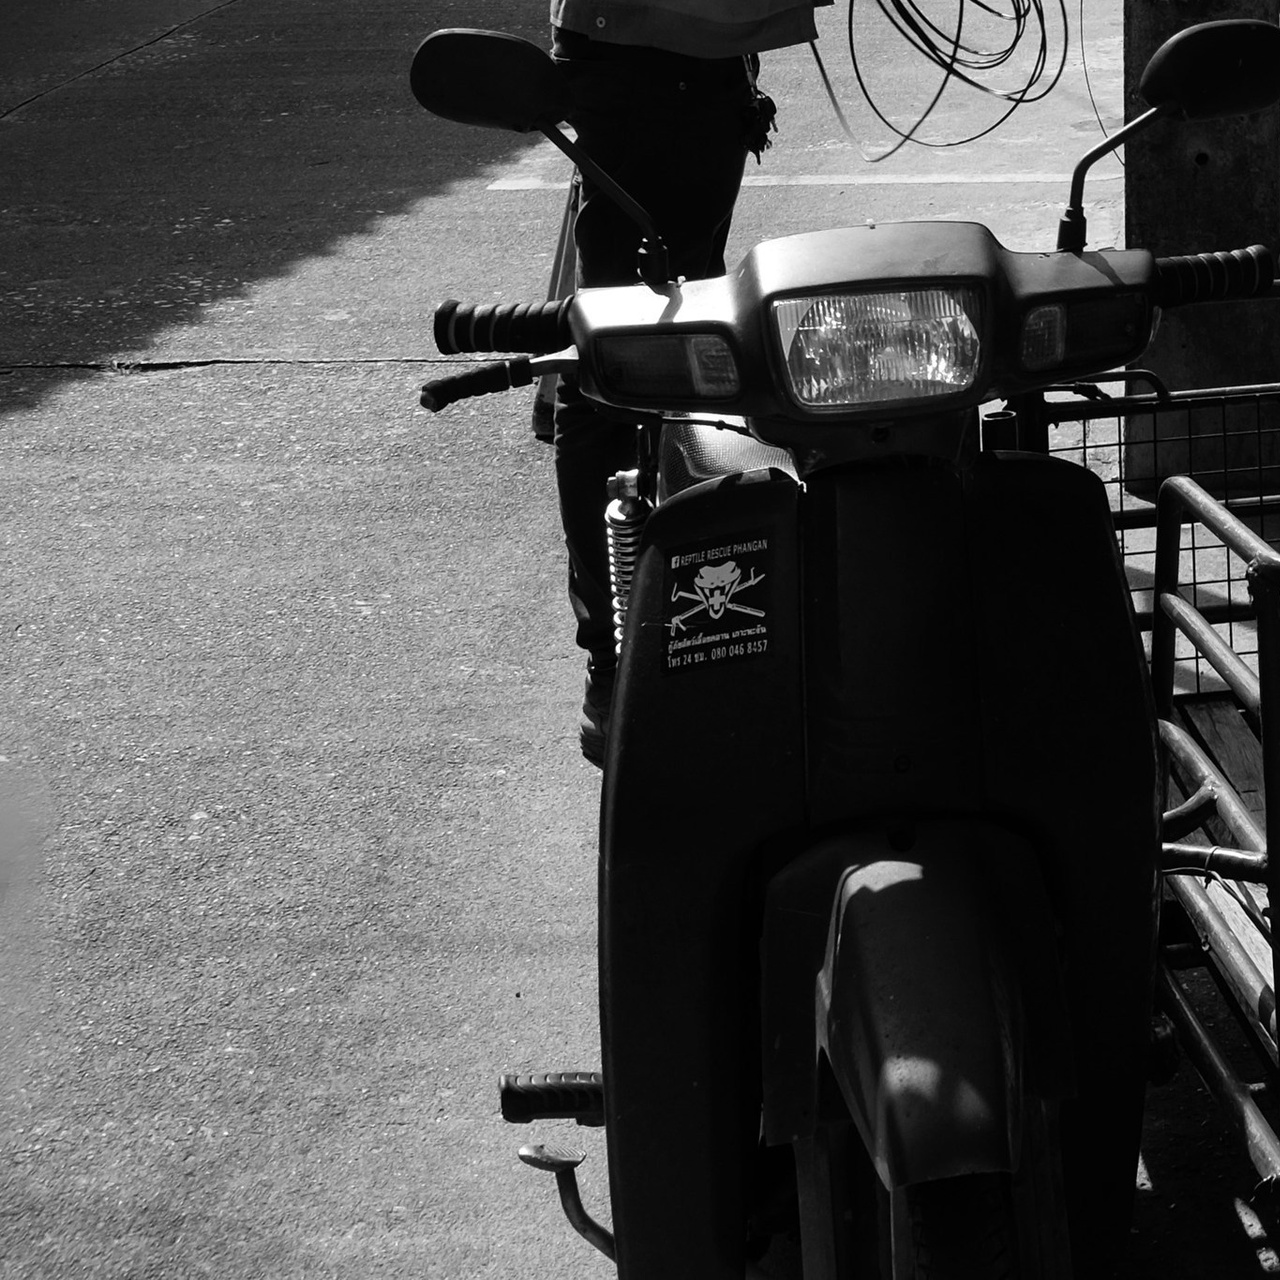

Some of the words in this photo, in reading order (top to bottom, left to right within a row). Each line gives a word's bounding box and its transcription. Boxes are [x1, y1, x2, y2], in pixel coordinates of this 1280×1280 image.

[680, 550, 705, 567] REPTILE
[706, 545, 731, 561] RESCUE
[733, 539, 768, 555] PHANGAN
[683, 653, 692, 666] 24
[711, 646, 727, 660] 080
[728, 643, 745, 657] 046
[746, 639, 768, 654] 8457
